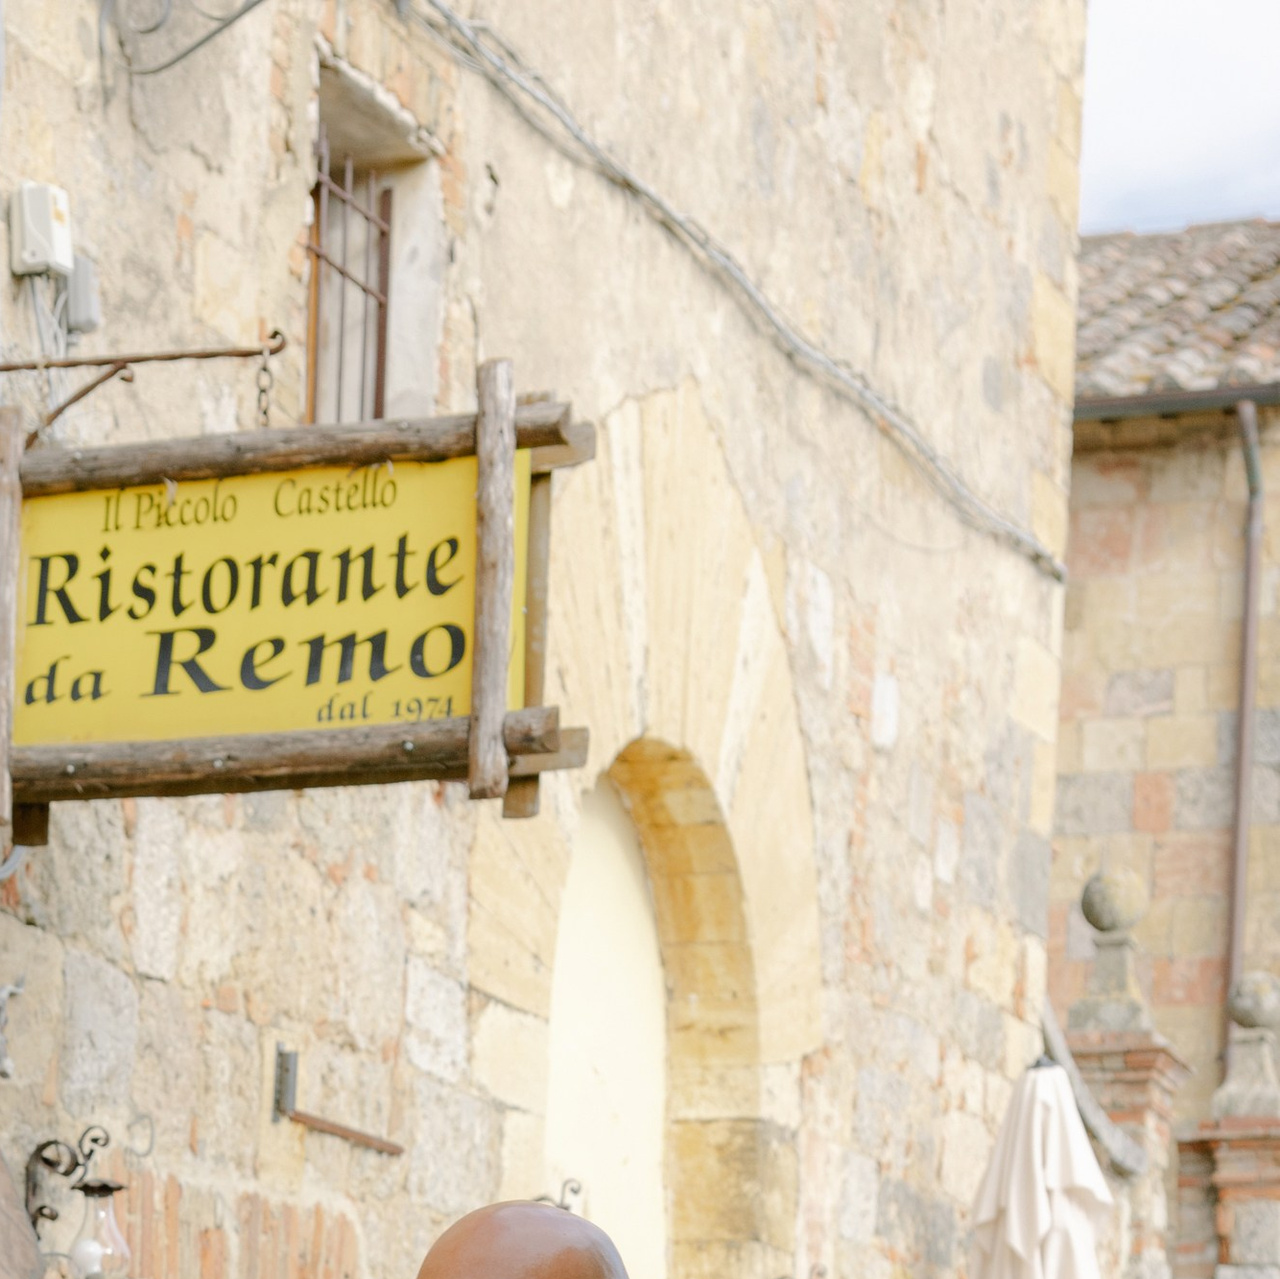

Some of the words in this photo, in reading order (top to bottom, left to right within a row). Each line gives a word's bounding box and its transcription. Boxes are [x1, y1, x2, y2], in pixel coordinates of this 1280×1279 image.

[102, 491, 124, 532] Il
[133, 482, 237, 530] Piccolo
[274, 463, 398, 518] Castello
[28, 532, 466, 626] Ristorante
[25, 655, 110, 706] da
[140, 622, 467, 698] Remo
[317, 690, 373, 722] dal
